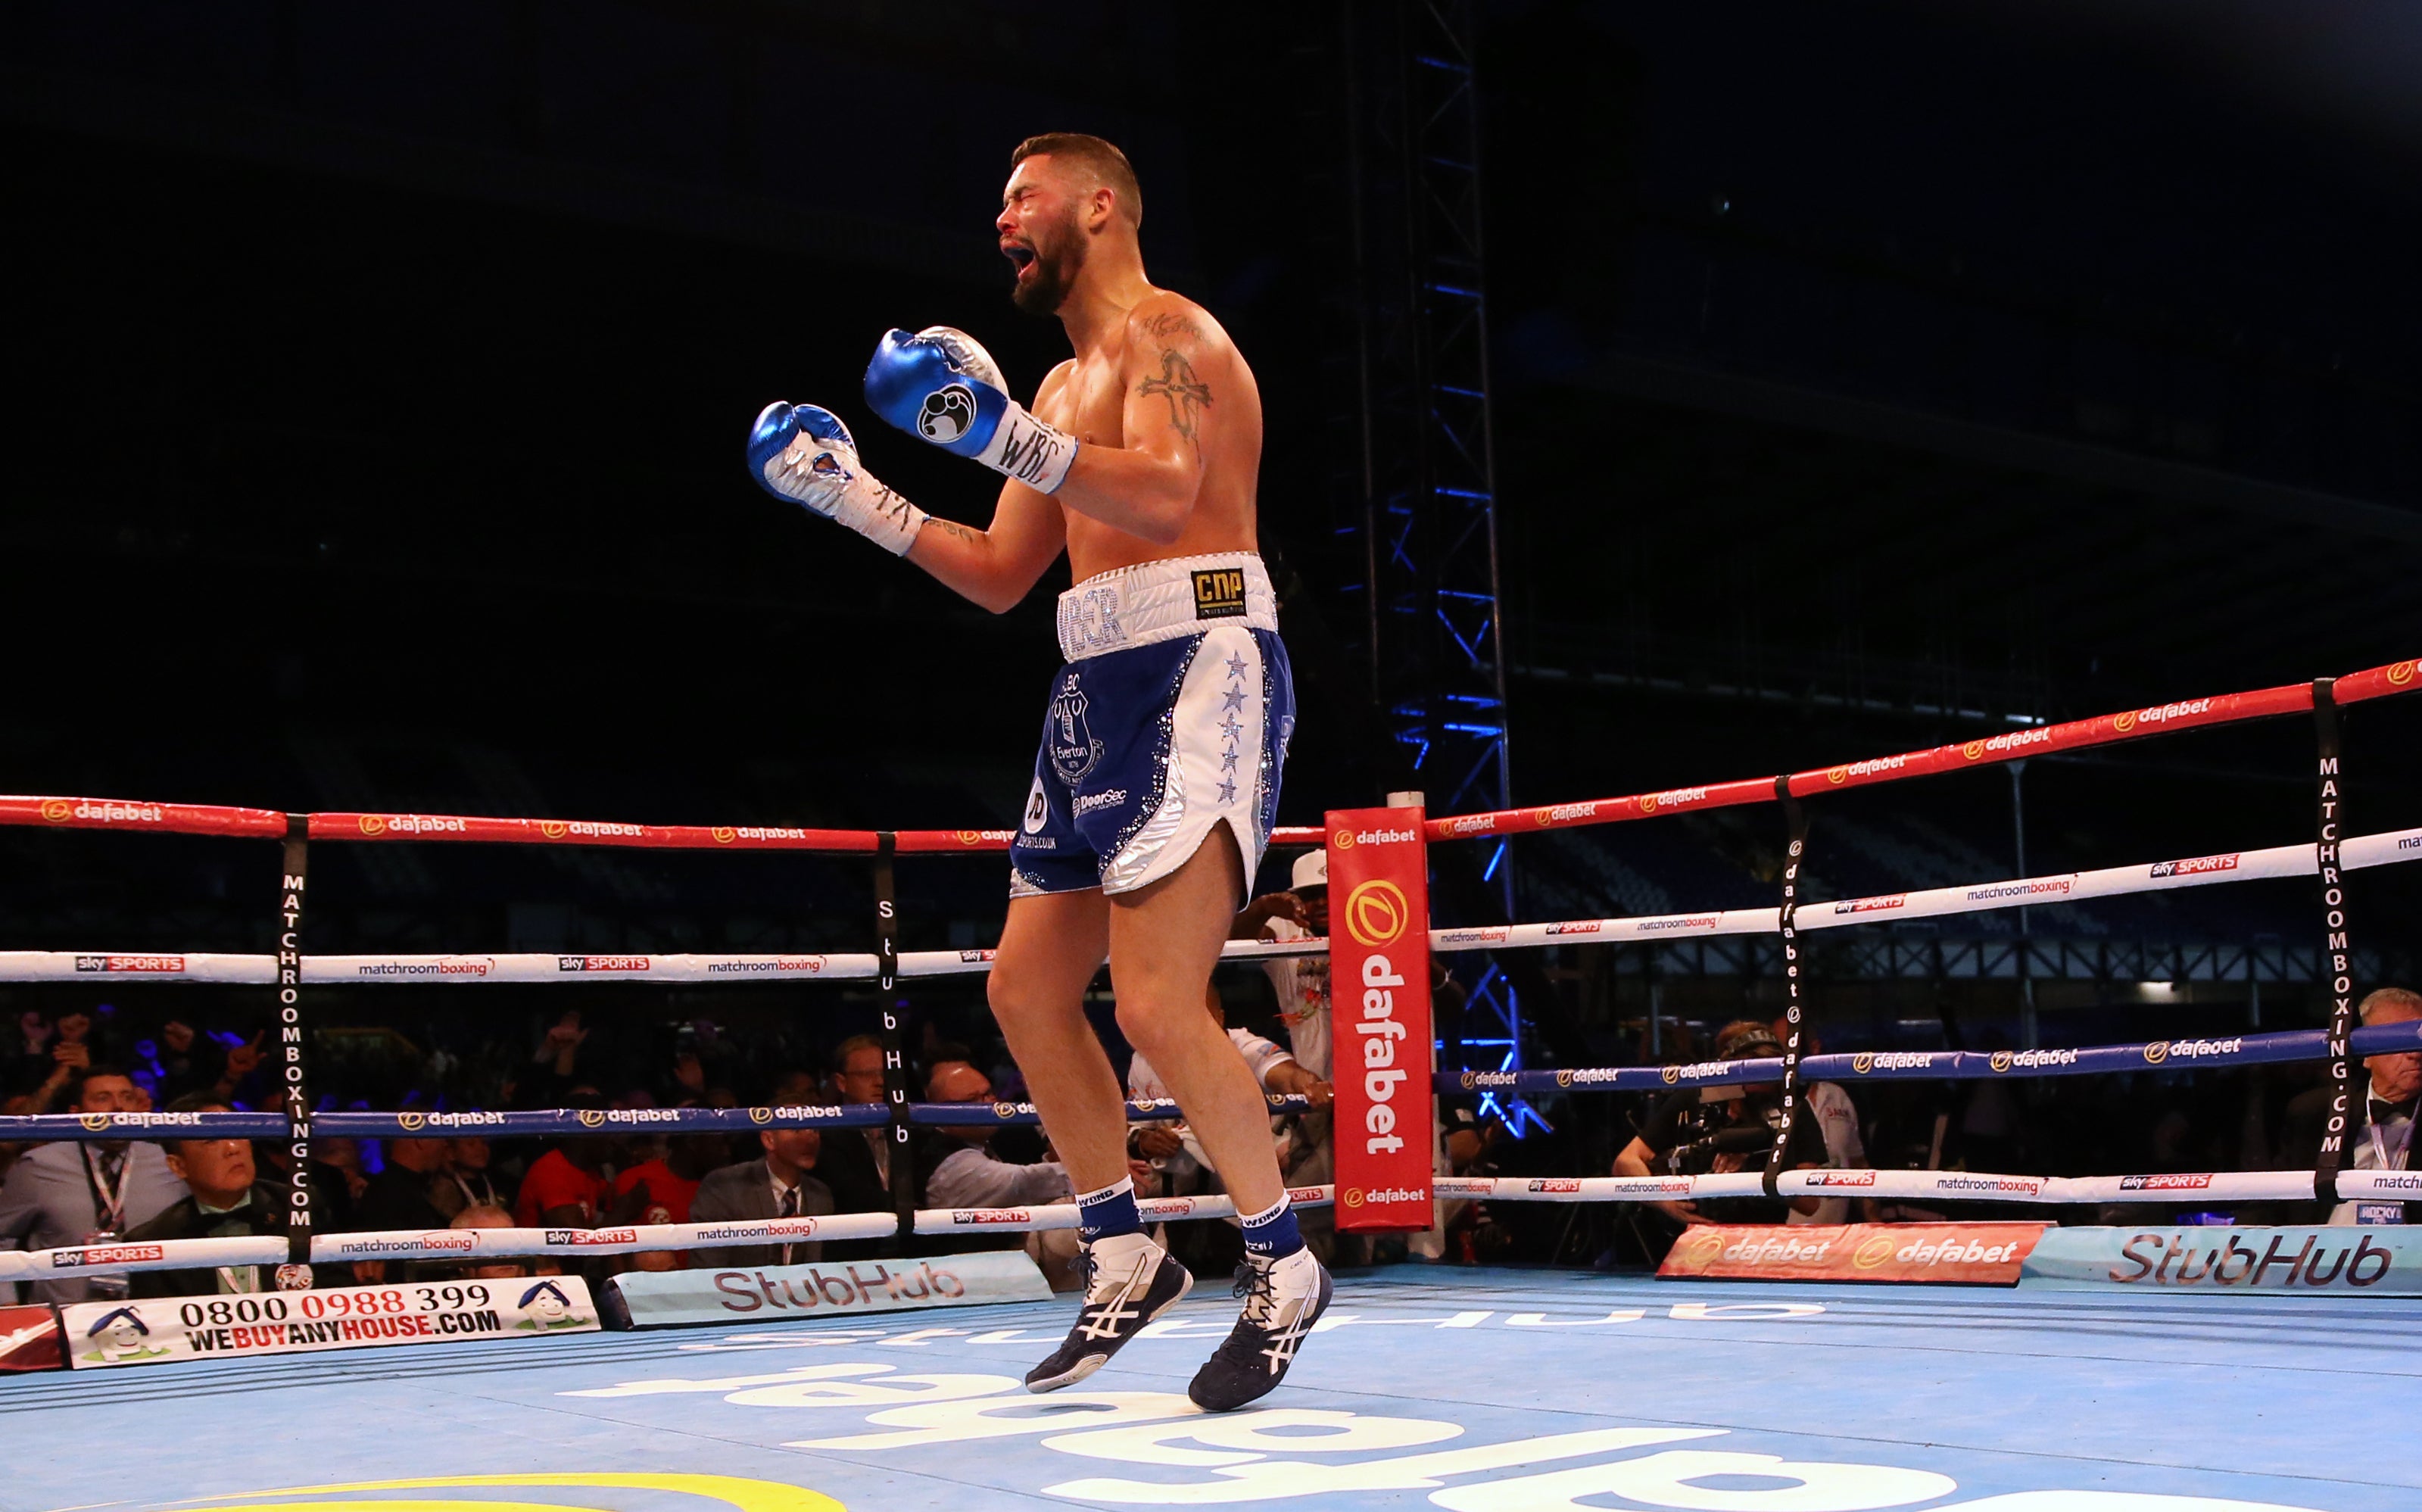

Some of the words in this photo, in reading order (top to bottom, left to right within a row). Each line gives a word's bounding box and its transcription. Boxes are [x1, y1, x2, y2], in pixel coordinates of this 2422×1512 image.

[1197, 572, 1242, 600] CNP
[2139, 698, 2210, 723] dafabet
[1985, 726, 2050, 751] dafabet
[1057, 746, 1088, 759] Everton
[1848, 756, 1906, 777] dafabet
[1027, 793, 1044, 819] JD
[1080, 789, 1127, 809] DoorSec
[1657, 788, 1707, 807] dafabet
[75, 802, 162, 822] dafabet
[1551, 803, 1595, 821] dafabet
[388, 815, 466, 834] dafabet
[569, 821, 643, 838] dafabet
[1454, 814, 1495, 833] dafabet
[737, 826, 806, 842] dafabet
[1355, 828, 1416, 845] dafabet
[2151, 862, 2175, 878] sky
[2177, 855, 2238, 874] SPORTS
[1967, 878, 2070, 901] matchroomboxing
[1835, 899, 1856, 913] sky
[1856, 895, 1905, 911] SPORTS
[1562, 921, 1601, 933] SPORTS
[1638, 916, 1716, 932] matchroomboxing
[1783, 863, 1798, 998] dafabet
[1441, 928, 1507, 943] matchroomboxing
[77, 956, 105, 972] sky
[110, 956, 182, 971] SPORTS
[560, 957, 585, 971] sky
[588, 956, 648, 971] SPORTS
[962, 950, 982, 963] sky
[2320, 757, 2350, 1154] MATCHROOMBOXING.COM
[358, 959, 488, 977] matchroomboxing
[708, 957, 821, 974] matchroomboxing
[878, 900, 909, 1143] StubHub
[280, 874, 310, 1227] MATCHROOMBOXING.COM
[1355, 953, 1407, 1155] dafabet
[2169, 1038, 2242, 1058] dafabet
[1873, 1052, 1932, 1069] dafabet
[2013, 1048, 2078, 1067] dafabet
[1474, 1071, 1516, 1086] dafabet
[1573, 1067, 1618, 1084] dafabet
[1679, 1061, 1729, 1079] dafabet
[1772, 1032, 1800, 1164] dafabet
[113, 1111, 202, 1127] dafabet
[428, 1111, 506, 1127] dafabet
[607, 1108, 681, 1124] dafabet
[774, 1105, 843, 1121] dafabet
[1545, 1180, 1580, 1192] SPORTS
[1614, 1179, 1690, 1194] matchroomboxing
[1807, 1173, 1826, 1186] sky
[1829, 1171, 1875, 1185] SPORTS
[1936, 1177, 2039, 1196] matchroomboxing
[2121, 1177, 2144, 1190] sky
[2146, 1174, 2211, 1189] SPORTS
[1366, 1186, 1426, 1205] dafabet
[954, 1211, 974, 1224] sky
[977, 1211, 1030, 1223] SPORTS
[547, 1231, 572, 1245] sky
[573, 1230, 635, 1244] SPORTS
[697, 1222, 811, 1240] matchroomboxing
[341, 1236, 472, 1253] matchroomboxing
[1723, 1236, 1831, 1263] dafabet
[1895, 1239, 2018, 1264] dafabet
[55, 1251, 83, 1266] sky
[88, 1246, 161, 1263] SPORTS
[2109, 1233, 2392, 1287] StubHub
[713, 1261, 965, 1312] StubHub
[180, 1297, 288, 1327] 0800
[304, 1289, 405, 1320] 0988
[416, 1285, 491, 1311] 399
[185, 1310, 501, 1351] WEBUYANYHOUSE.COM
